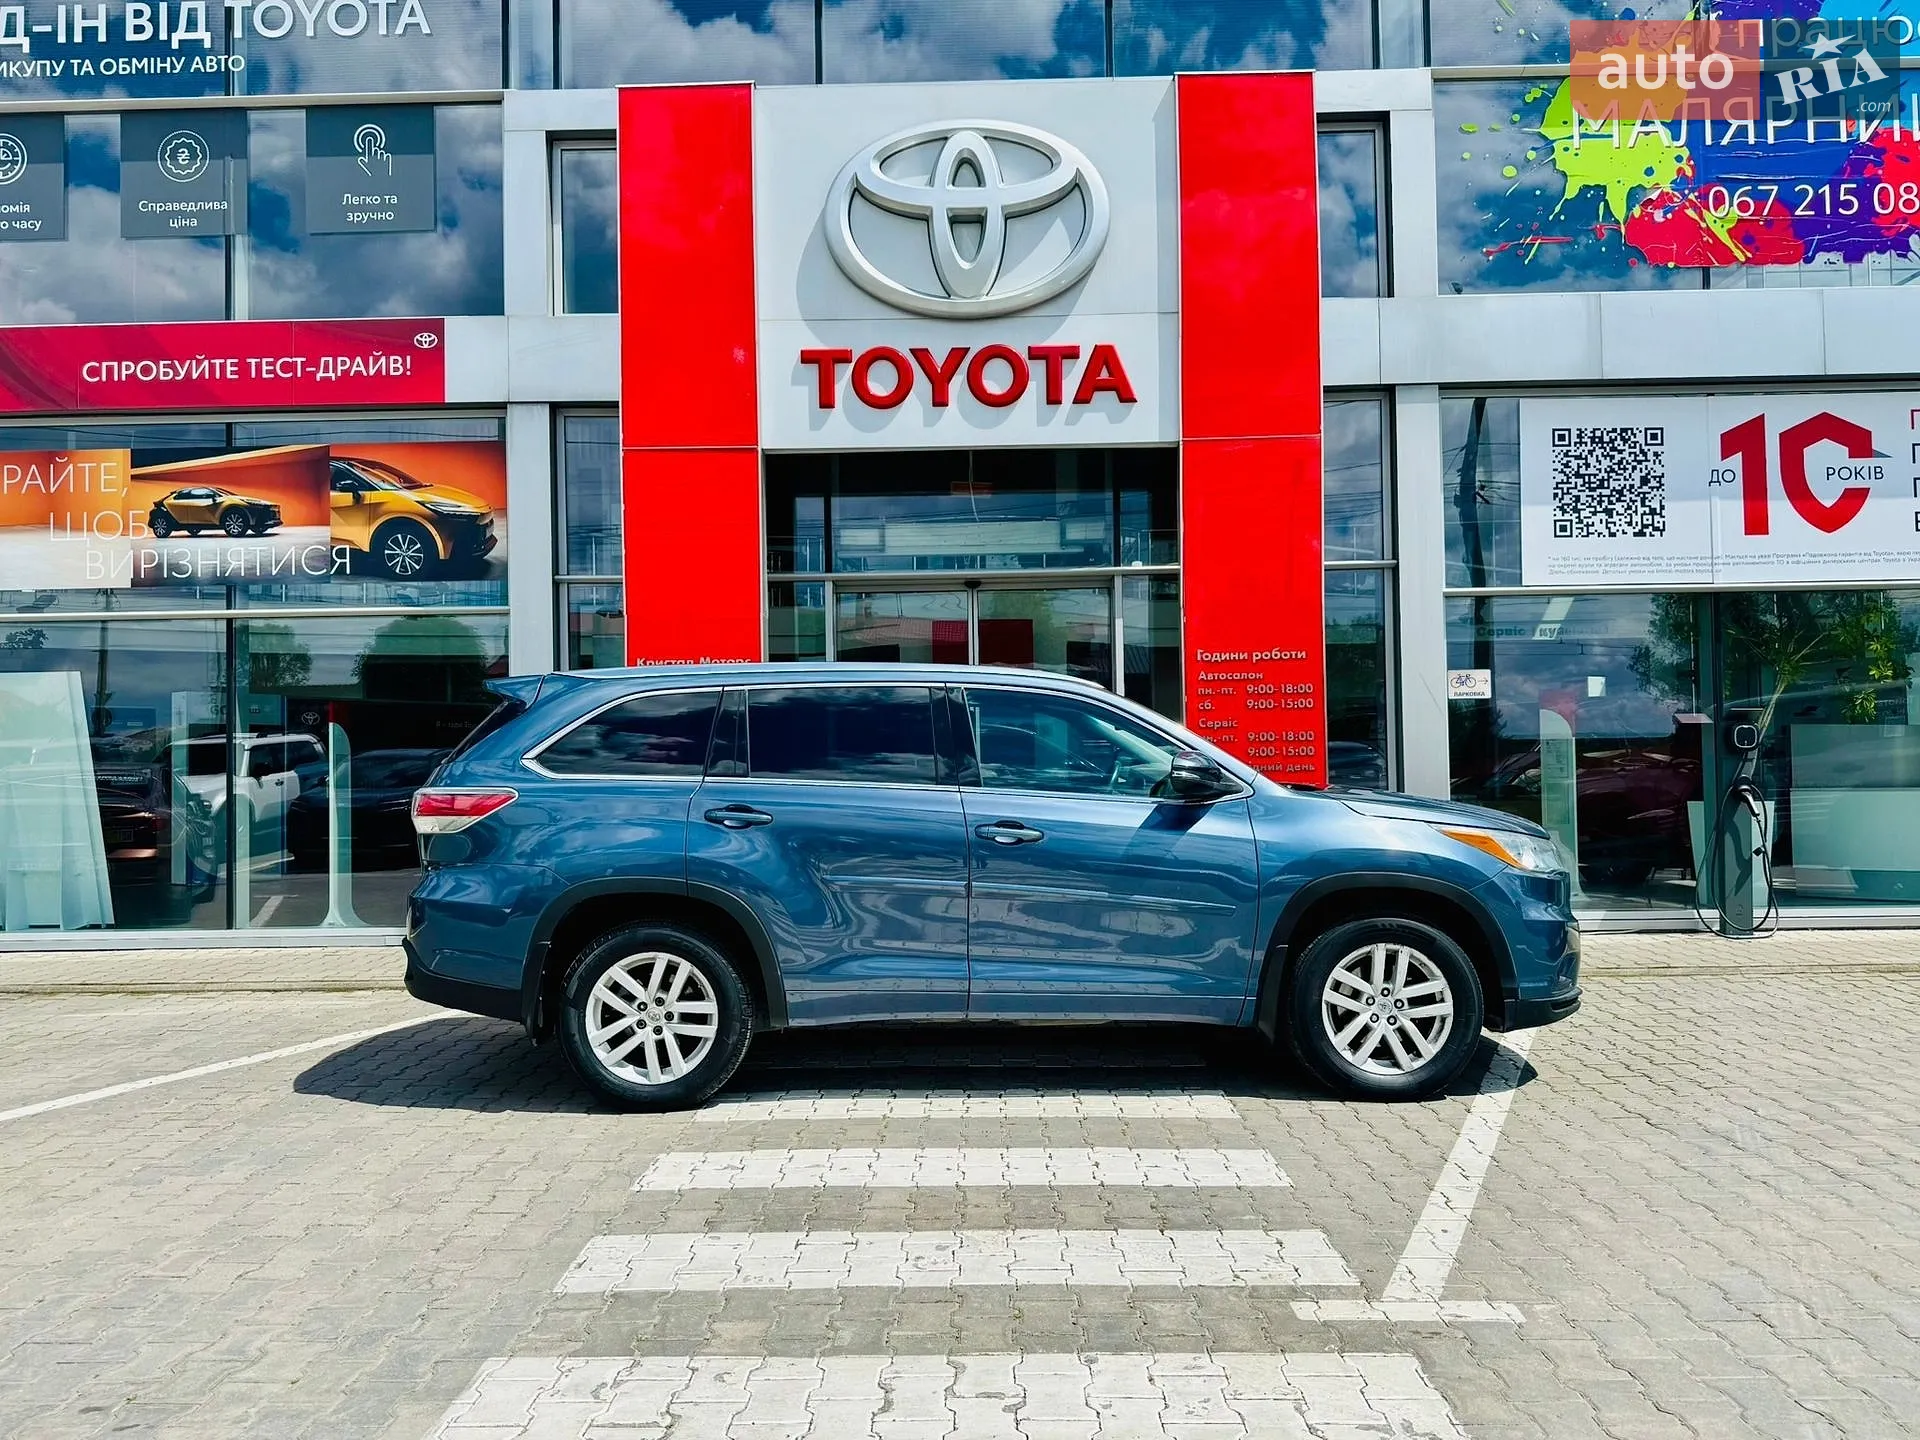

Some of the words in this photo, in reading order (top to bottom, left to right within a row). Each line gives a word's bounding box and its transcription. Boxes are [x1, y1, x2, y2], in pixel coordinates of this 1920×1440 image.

[125, 1, 212, 49] ВІД
[224, 0, 431, 38] TOYOTA
[1738, 15, 1920, 58] працю
[70, 59, 95, 76] ТА
[100, 56, 186, 75] ОБМІНУ
[190, 54, 245, 73] АВТО
[342, 193, 381, 205] Легко
[384, 195, 398, 204] та
[1708, 185, 1779, 217] 067
[1794, 183, 1859, 215] 215
[1873, 182, 1920, 214] 08
[0, 201, 30, 213] омія
[138, 199, 228, 214] Справедлива
[169, 215, 198, 228] ціна
[346, 211, 395, 224] зручно
[12, 219, 42, 232] часу
[82, 354, 239, 382] СПРОБУЙТЕ
[246, 350, 412, 380] ТЕСТ-ДРАЙВ!
[800, 344, 1138, 410] TOYOTA
[3, 457, 129, 497] РАЙТЕ,
[1708, 469, 1736, 487] ДО
[1826, 465, 1884, 481] РОКІВ
[50, 510, 148, 547] ЩОБ
[86, 544, 351, 580] ВИРІЗНЯТИСЯ
[1197, 649, 1248, 662] Години
[1252, 647, 1307, 663] роботи
[1198, 671, 1263, 680] Автосалон
[1247, 684, 1313, 694] 9:00-18:00
[1198, 700, 1216, 710] сб.
[1247, 699, 1314, 709] 9:00-15:00
[1199, 717, 1239, 730] Сервіс
[1247, 731, 1315, 741] 9:00-18:00
[1248, 747, 1315, 756] 9:00-15:00
[1287, 765, 1315, 773] день
